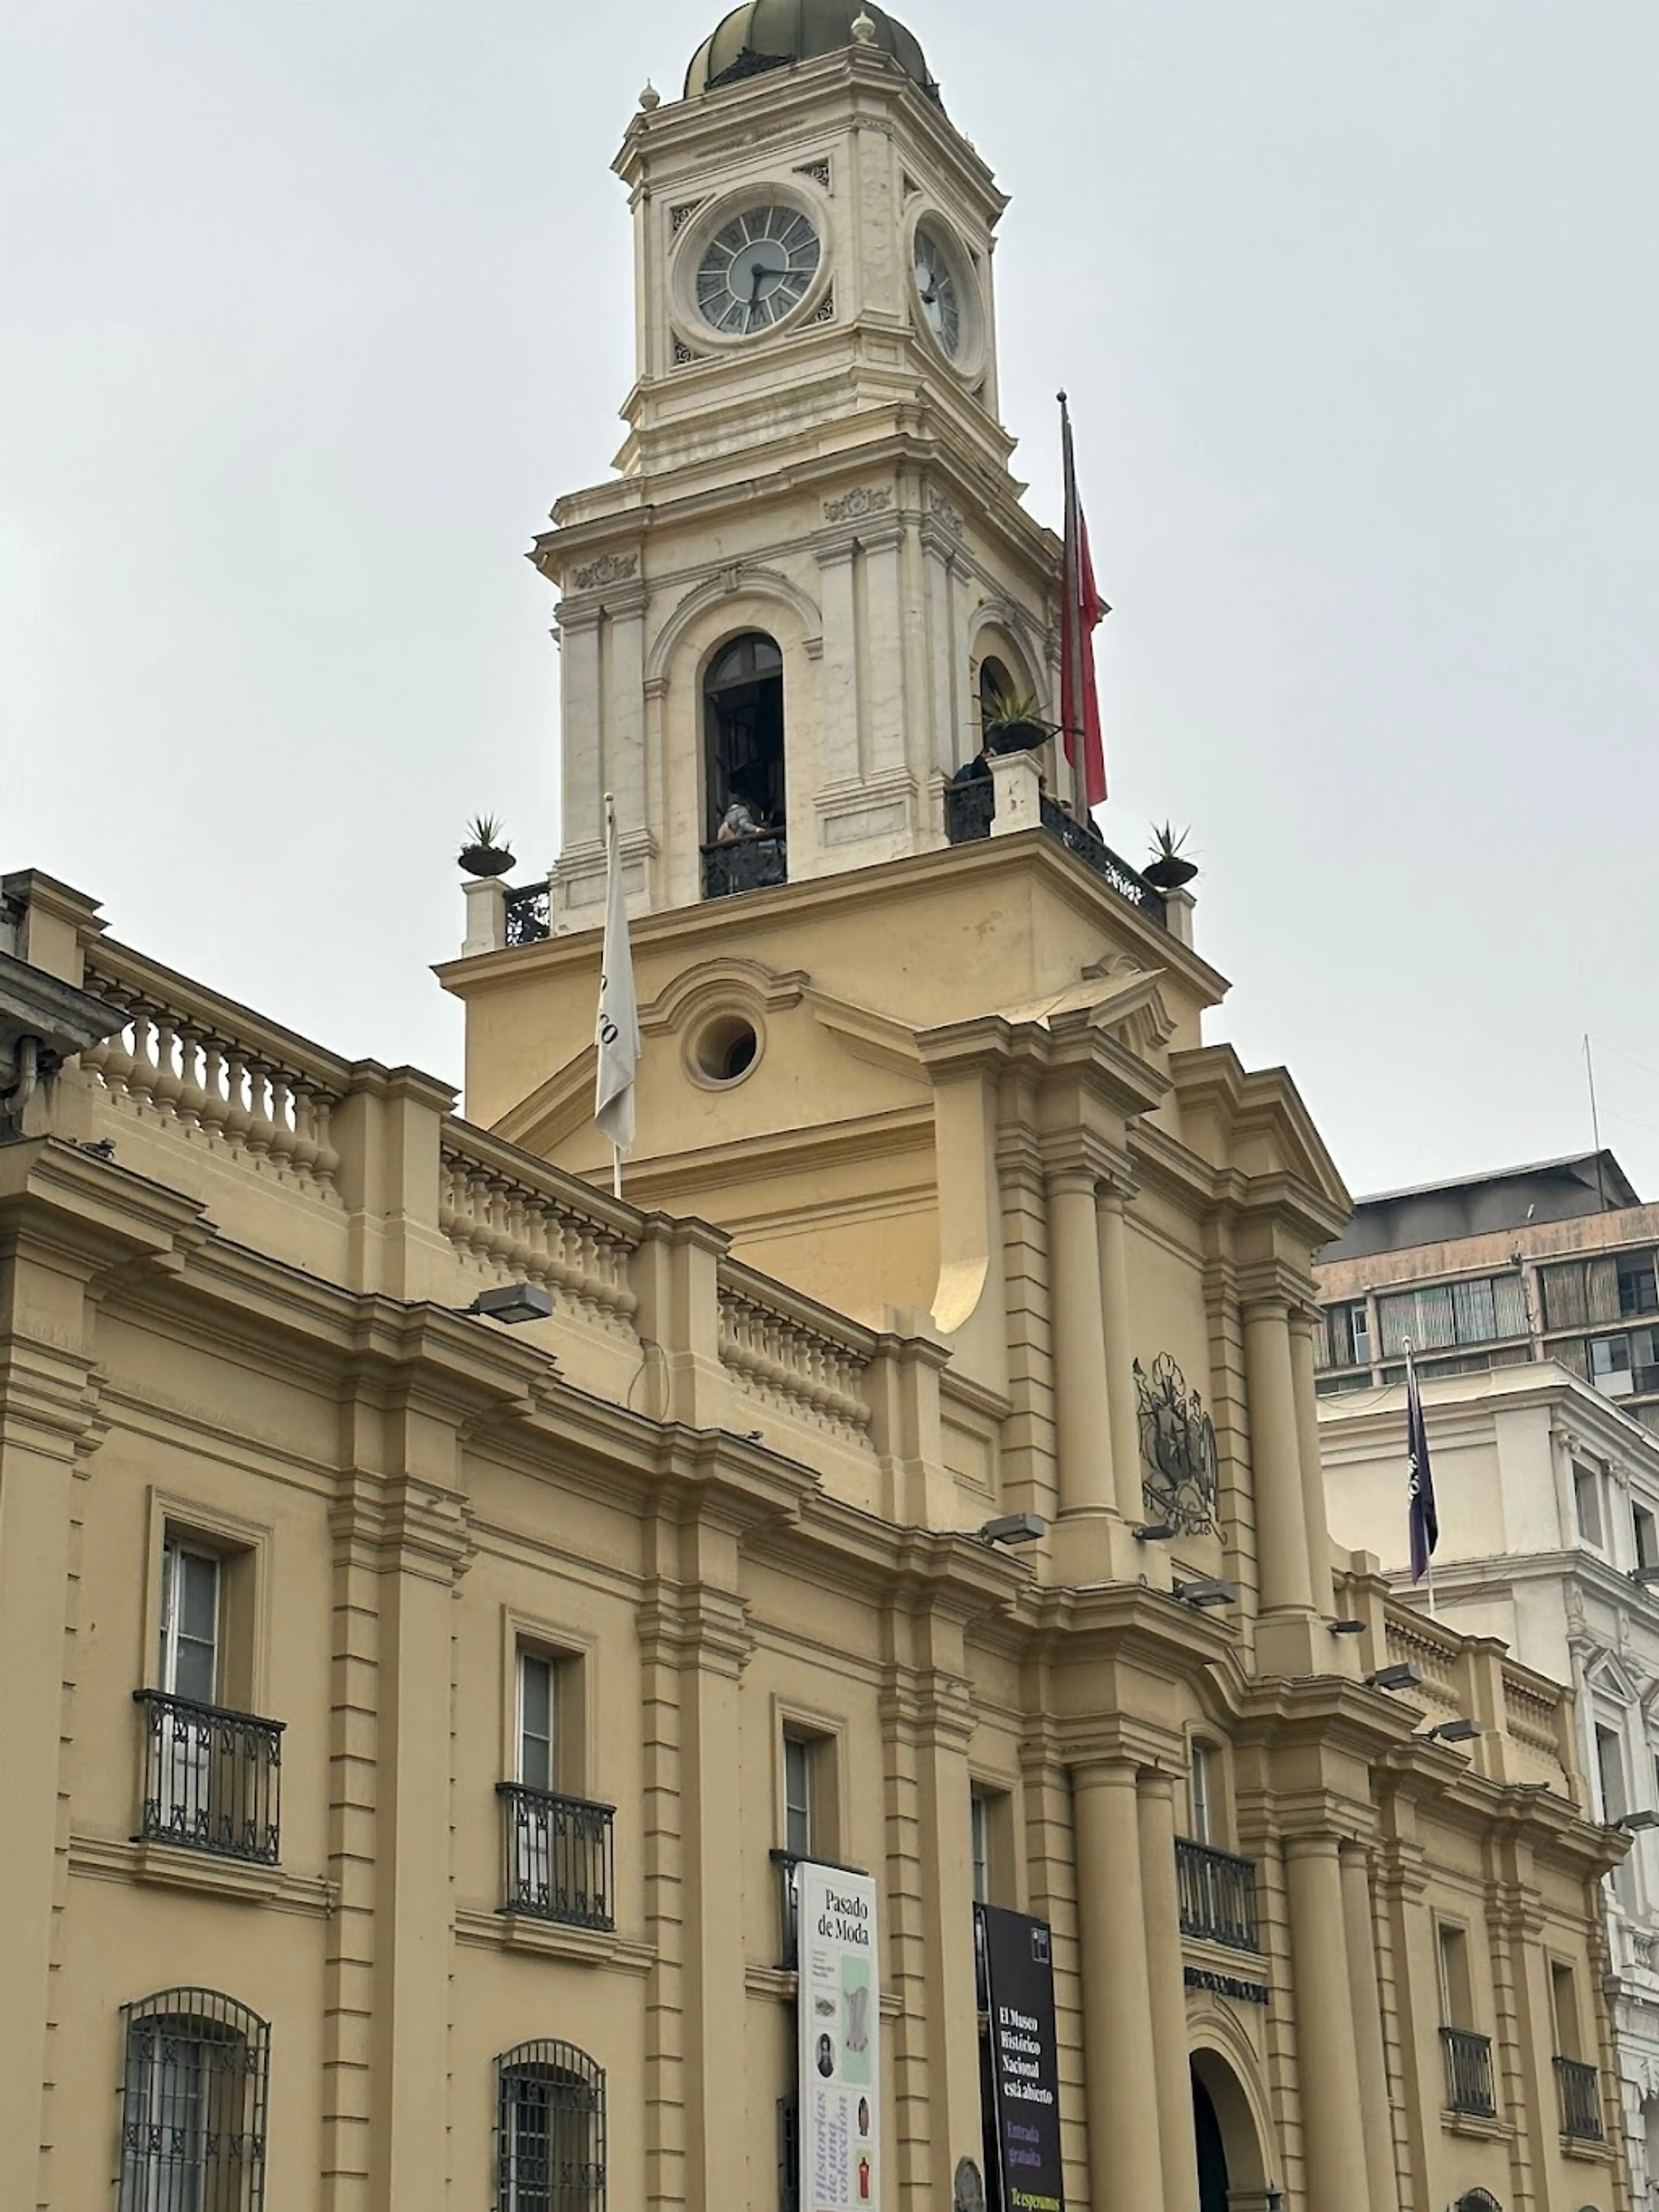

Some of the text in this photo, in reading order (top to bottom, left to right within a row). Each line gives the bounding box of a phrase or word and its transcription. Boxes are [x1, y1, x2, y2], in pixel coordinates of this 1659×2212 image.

[826, 1889, 868, 1919] Pasado
[818, 1914, 869, 1945] de Moda
[999, 2005, 1038, 2032] El Museo
[1001, 2030, 1041, 2056] Histórico
[1002, 2054, 1039, 2078] Nacional
[1004, 2079, 1053, 2105] está abierto
[814, 2090, 826, 2200] Historias
[1007, 2121, 1039, 2143] Entrada
[826, 2122, 838, 2203] de una
[836, 2096, 848, 2204] colección
[1009, 2148, 1041, 2167] gratuita
[1011, 2187, 1060, 2211] Te esperamos
